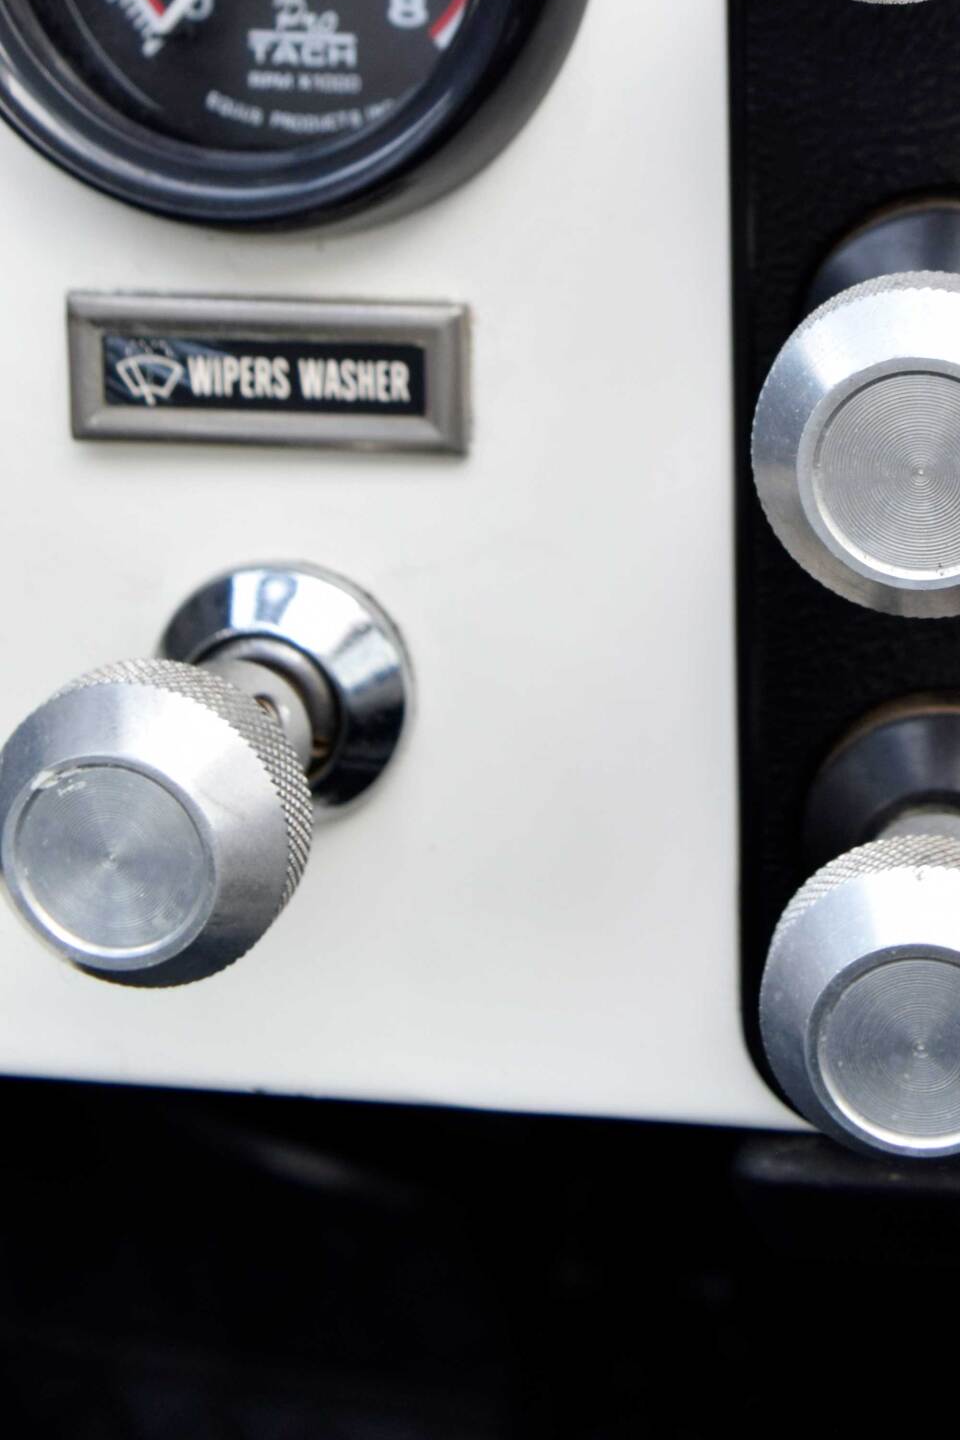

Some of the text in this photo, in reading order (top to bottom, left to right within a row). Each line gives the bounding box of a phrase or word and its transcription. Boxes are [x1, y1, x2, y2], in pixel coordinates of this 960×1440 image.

[248, 29, 358, 68] TACH
[186, 356, 411, 403] WIPERS WASHER
